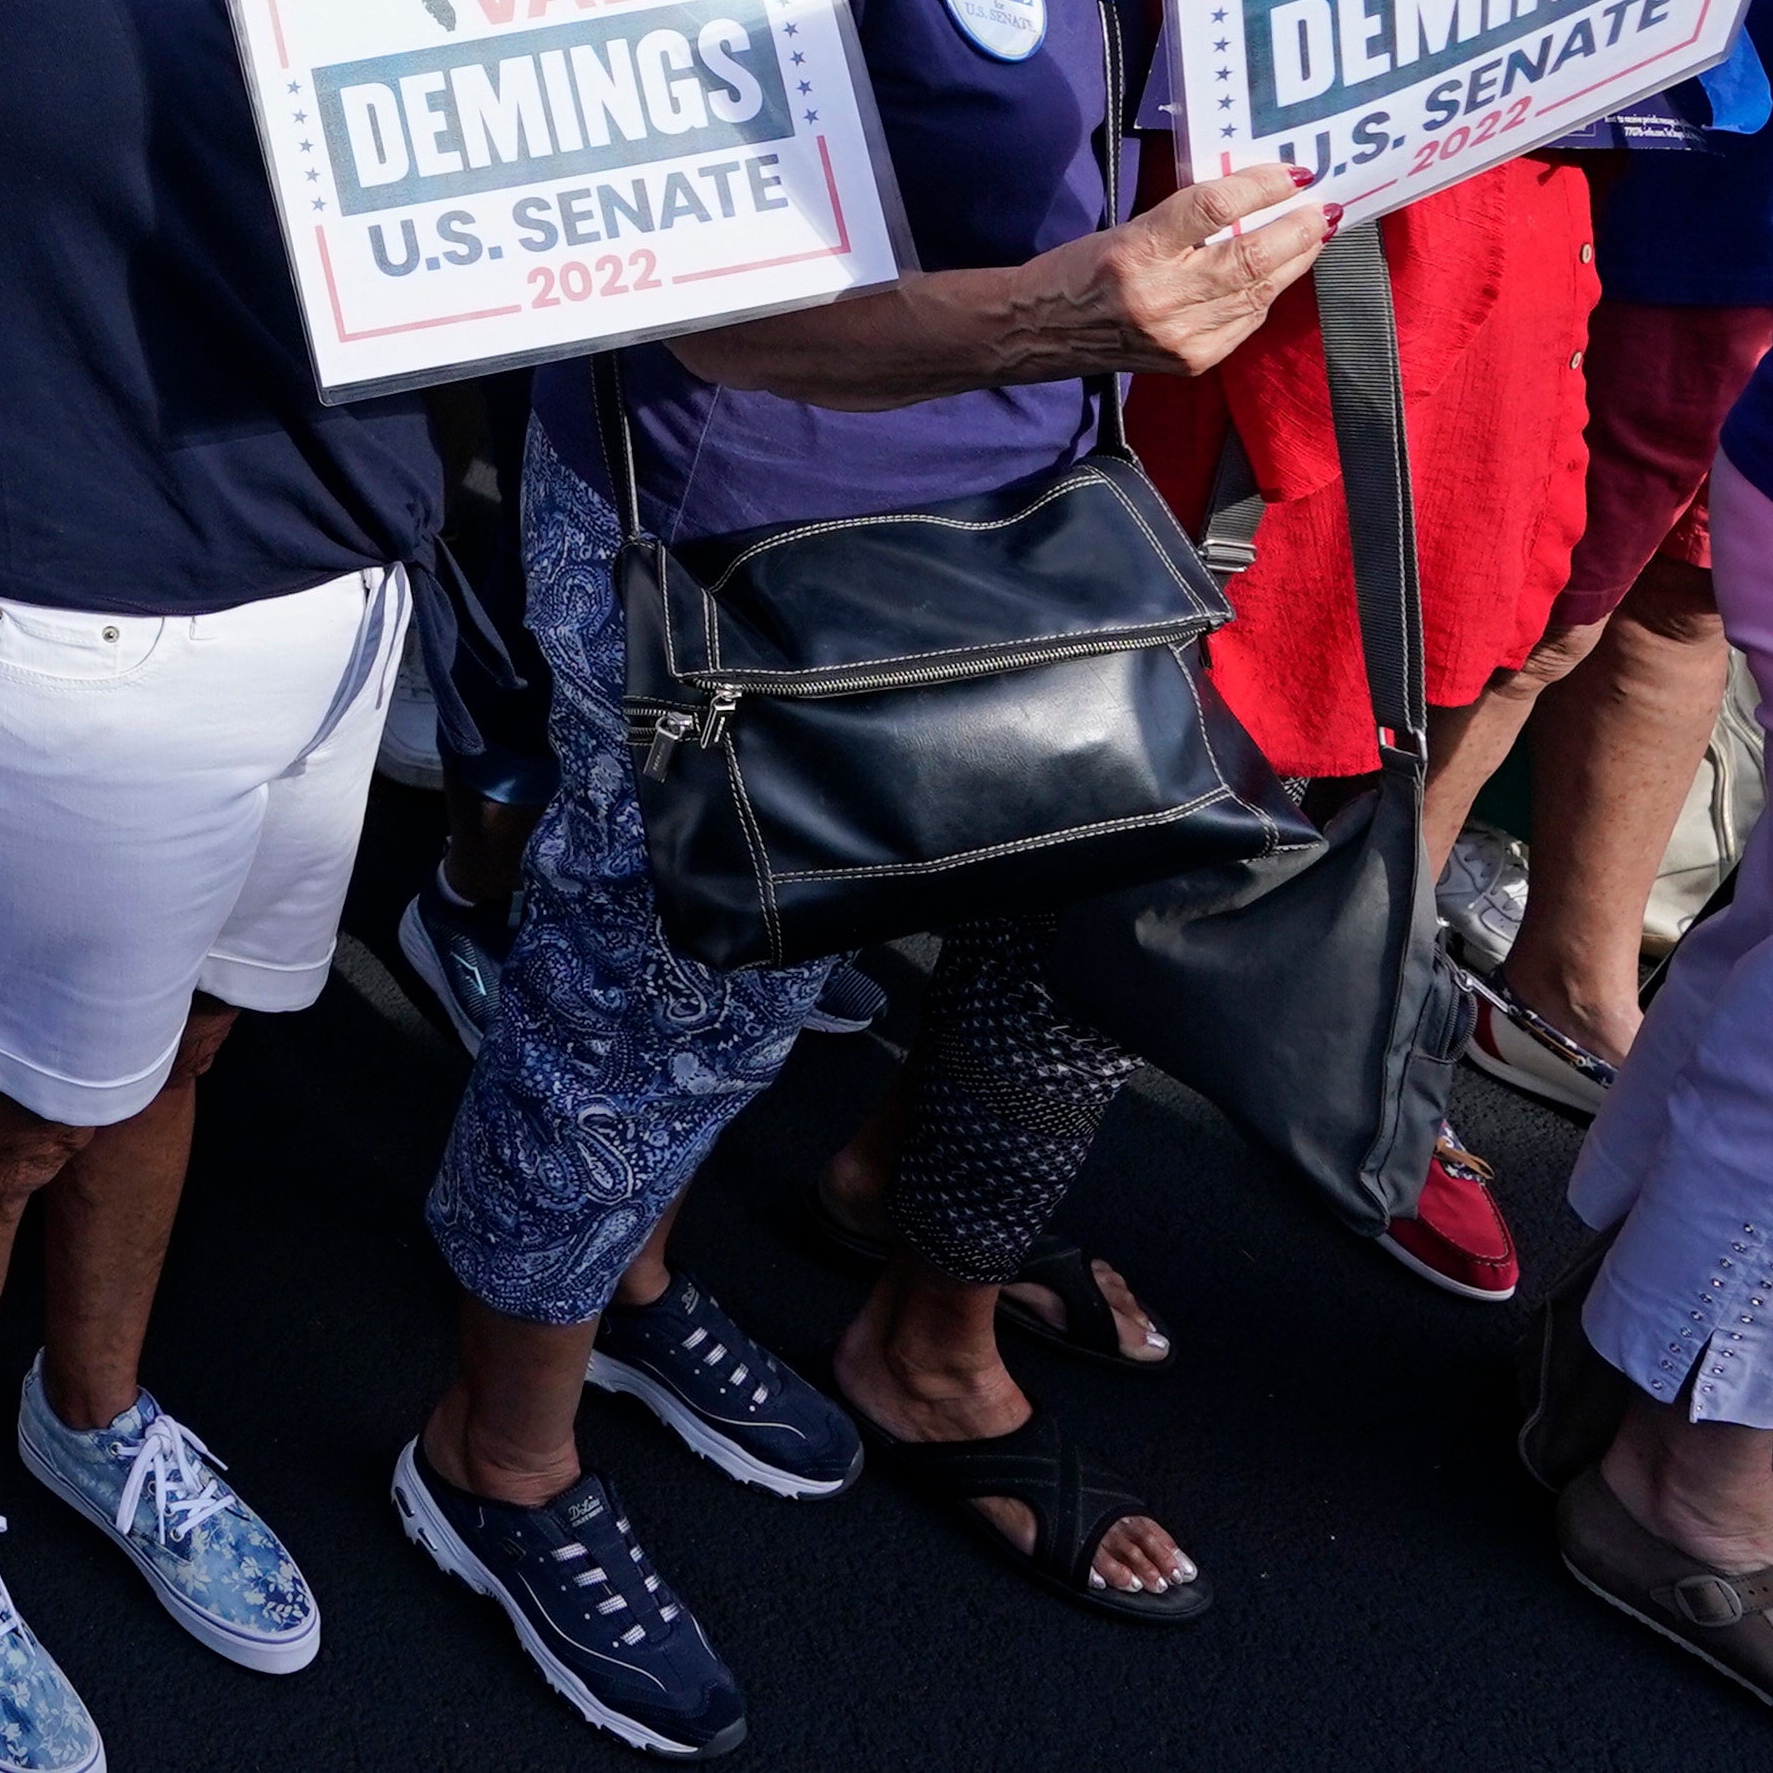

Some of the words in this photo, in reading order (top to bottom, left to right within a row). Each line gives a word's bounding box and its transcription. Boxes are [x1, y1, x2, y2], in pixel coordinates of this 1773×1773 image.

[965, 2, 987, 19] U.S.
[989, 9, 1036, 33] SENATE
[339, 18, 763, 190] DEMINGS
[1407, 96, 1535, 179] 2022
[1279, 111, 1405, 191] U.S.
[368, 211, 503, 278] U.S.
[517, 154, 789, 253] SENATE
[528, 248, 663, 310] 2022
